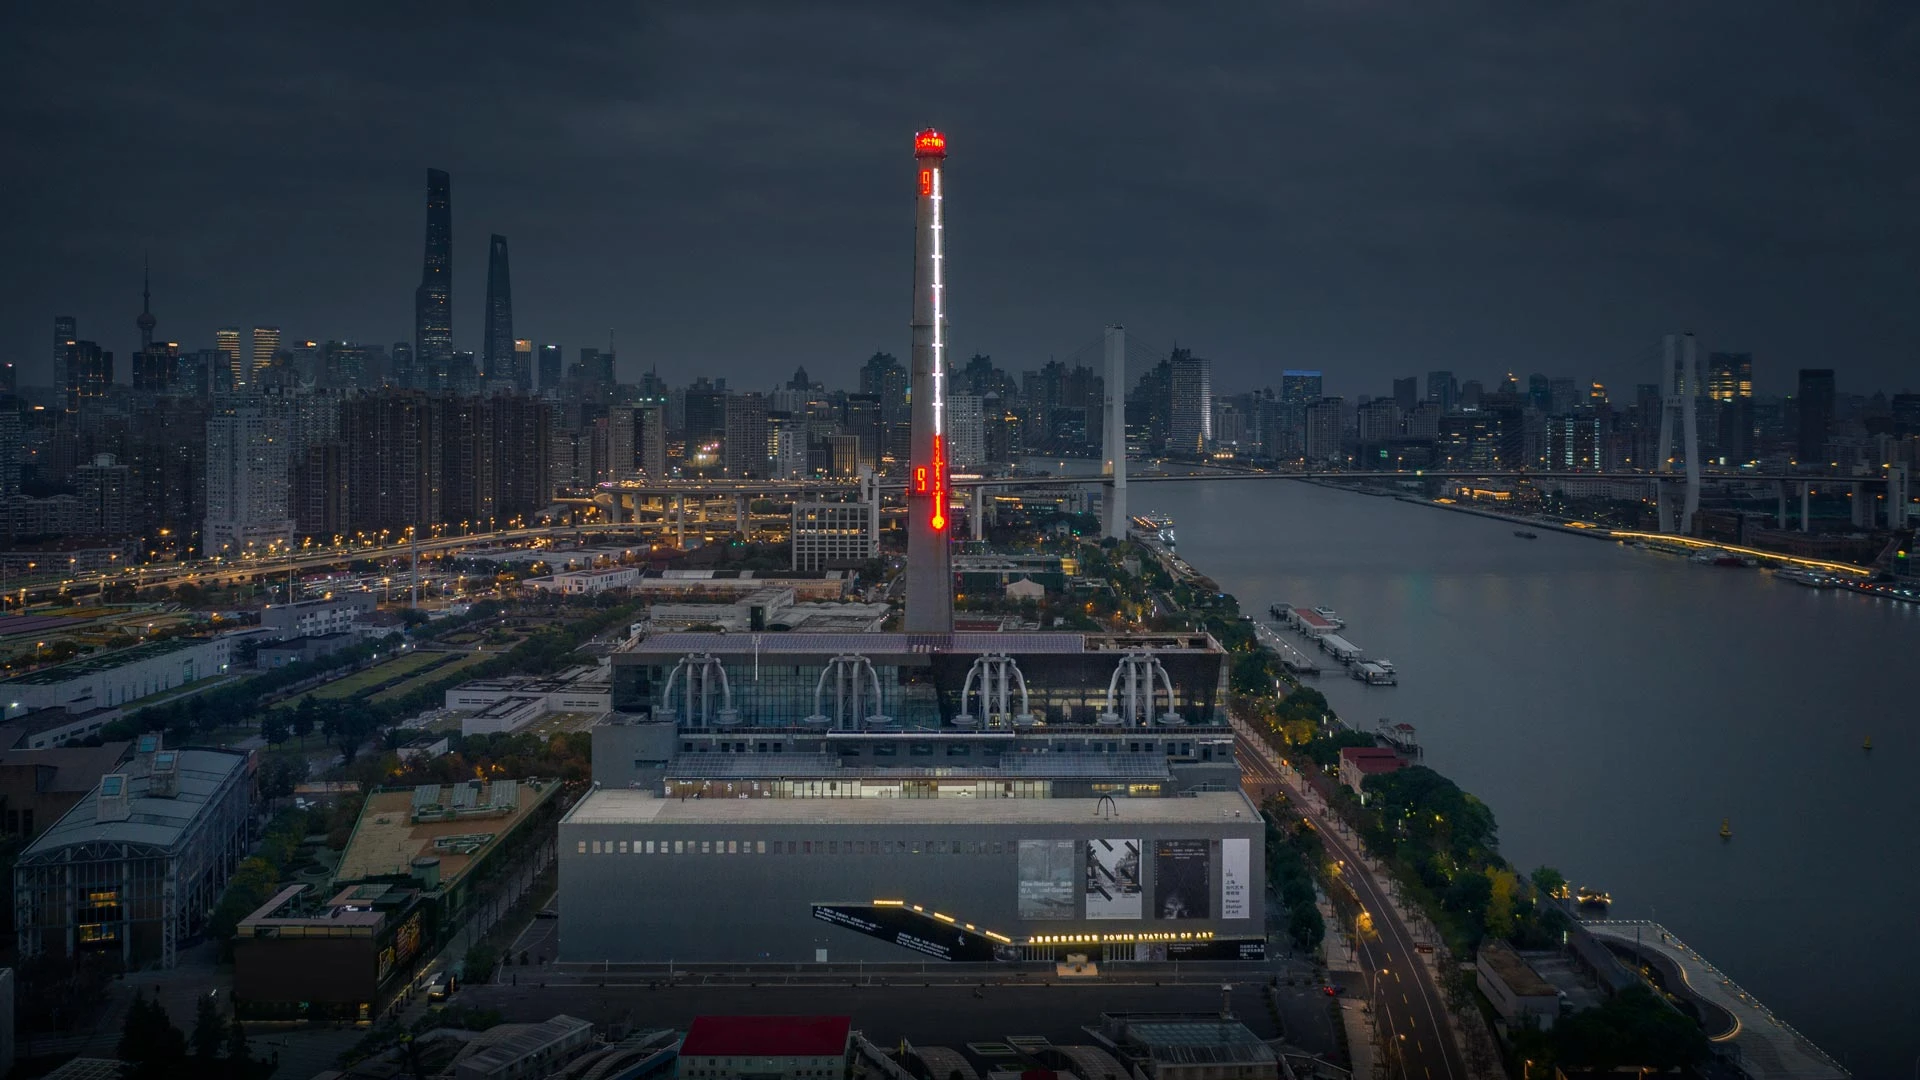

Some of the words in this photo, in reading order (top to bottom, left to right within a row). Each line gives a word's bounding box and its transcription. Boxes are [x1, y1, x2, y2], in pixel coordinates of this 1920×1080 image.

[917, 468, 926, 491] 9
[1103, 933, 1134, 941] POWER
[1138, 932, 1176, 940] STATION
[1180, 931, 1192, 939] OF
